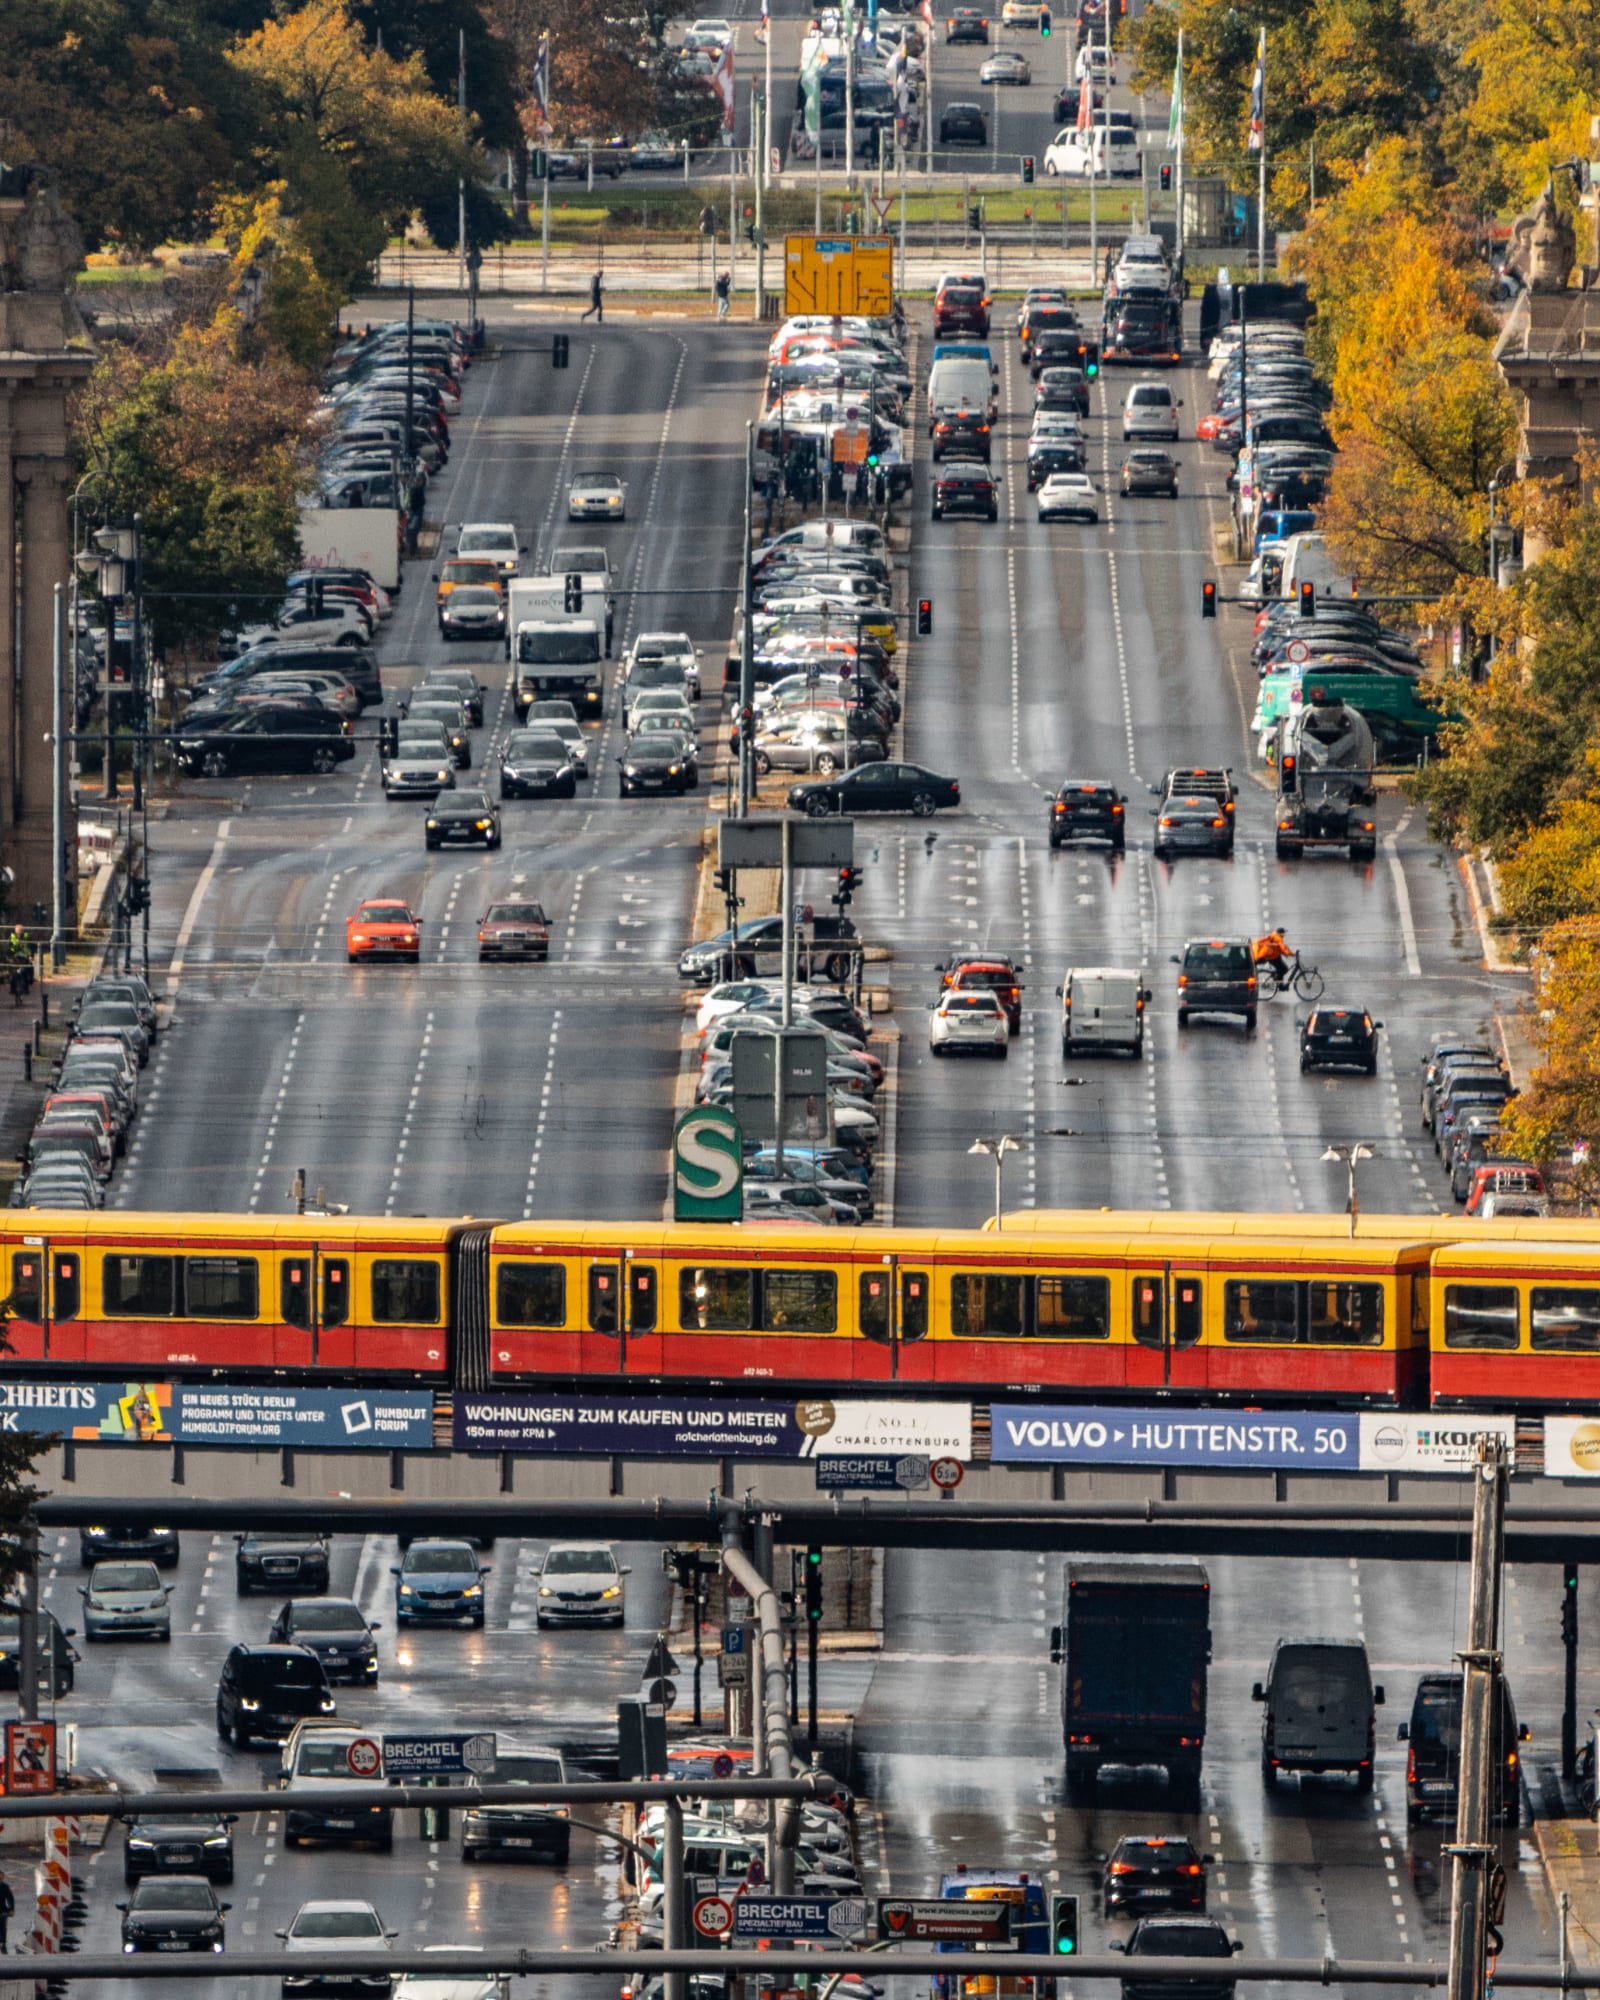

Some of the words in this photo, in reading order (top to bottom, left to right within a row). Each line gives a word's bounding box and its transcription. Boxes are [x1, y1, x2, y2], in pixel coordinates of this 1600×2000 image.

[677, 1119, 739, 1198] S
[182, 1394, 198, 1404] EIN
[200, 1394, 229, 1406] NEUES
[232, 1393, 260, 1407] STÜCK
[263, 1396, 296, 1407] BERLIN
[182, 1408, 233, 1419] PROGRAMM
[235, 1409, 254, 1420] UND
[256, 1410, 293, 1421] TICKETS
[295, 1411, 325, 1422] UNTER
[374, 1407, 427, 1420] HUMBOLDT
[465, 1405, 574, 1424] WOHNUNGEN
[578, 1408, 614, 1425] ZUM
[617, 1409, 683, 1426] KAUFEN
[687, 1411, 724, 1426] UND
[727, 1412, 787, 1428] MIETEN
[0, 1411, 19, 1432] K
[182, 1422, 280, 1435] HUMBOLDTFORUM.ORG
[374, 1420, 409, 1431] FORUM
[465, 1425, 496, 1438] 150m
[497, 1428, 520, 1439] near
[522, 1427, 545, 1439] KPM
[1006, 1421, 1107, 1448] VOLVO
[1131, 1424, 1305, 1453] HUTTENSTR.
[1314, 1428, 1347, 1454] 50
[835, 1435, 960, 1447] CHARLOTTENBURG
[819, 1460, 893, 1473] BRECHTEL
[729, 1632, 739, 1651] P
[385, 1743, 460, 1757] BRECHTEL
[738, 1904, 825, 1919] BRECHTEL
[737, 1920, 804, 1928] SPEZIALTIEFBAU
